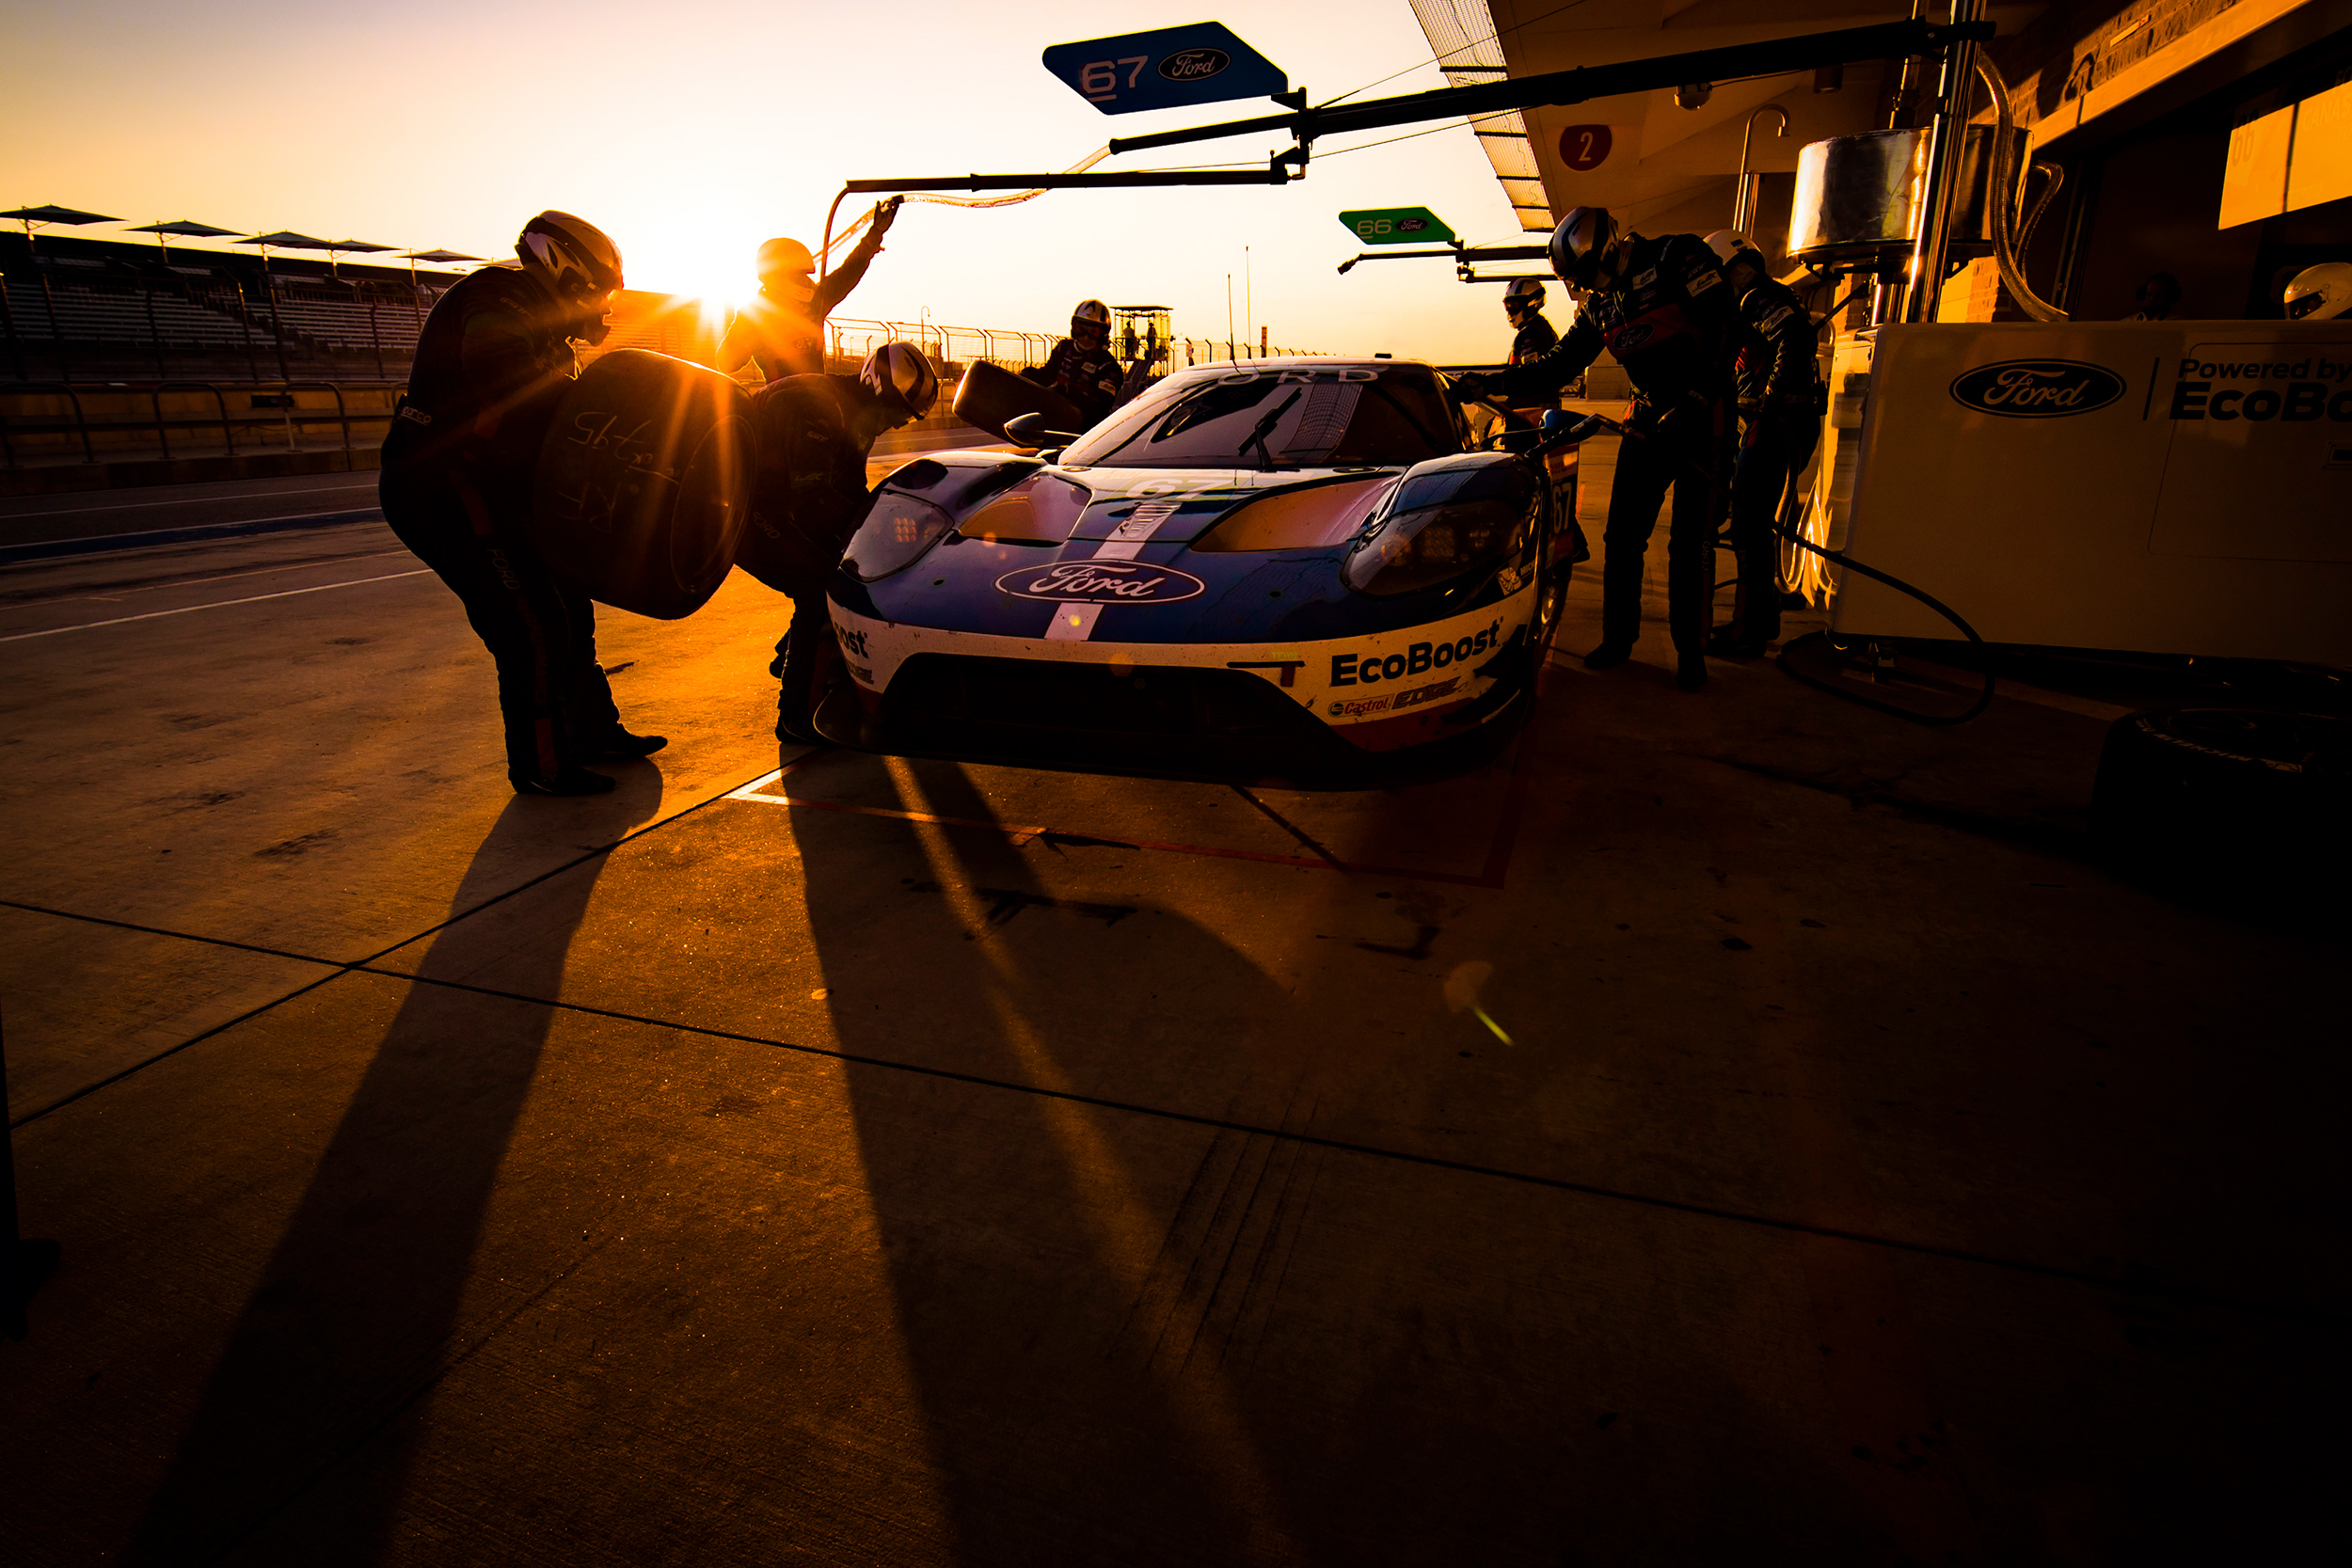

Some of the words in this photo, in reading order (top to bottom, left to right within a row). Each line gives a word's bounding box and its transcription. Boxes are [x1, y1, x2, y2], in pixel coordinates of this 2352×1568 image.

[1079, 55, 1149, 95] 67
[1172, 53, 1216, 76] Ford
[1578, 132, 1594, 162] 2
[1357, 218, 1392, 235] 66
[1401, 218, 1423, 232] Ford
[1620, 328, 1646, 348] Ford
[1174, 369, 1379, 388] FORD
[2178, 357, 2312, 379] Powered
[2316, 357, 2352, 383] by
[1983, 368, 2090, 406] Ford
[1125, 479, 1234, 499] 67
[1553, 481, 1573, 535] 67
[486, 548, 520, 591] FORD
[1028, 564, 1166, 597] Ford
[1330, 619, 1500, 688] EcoBoost
[1343, 697, 1390, 715] Castrol
[1392, 675, 1462, 710] EDGE
